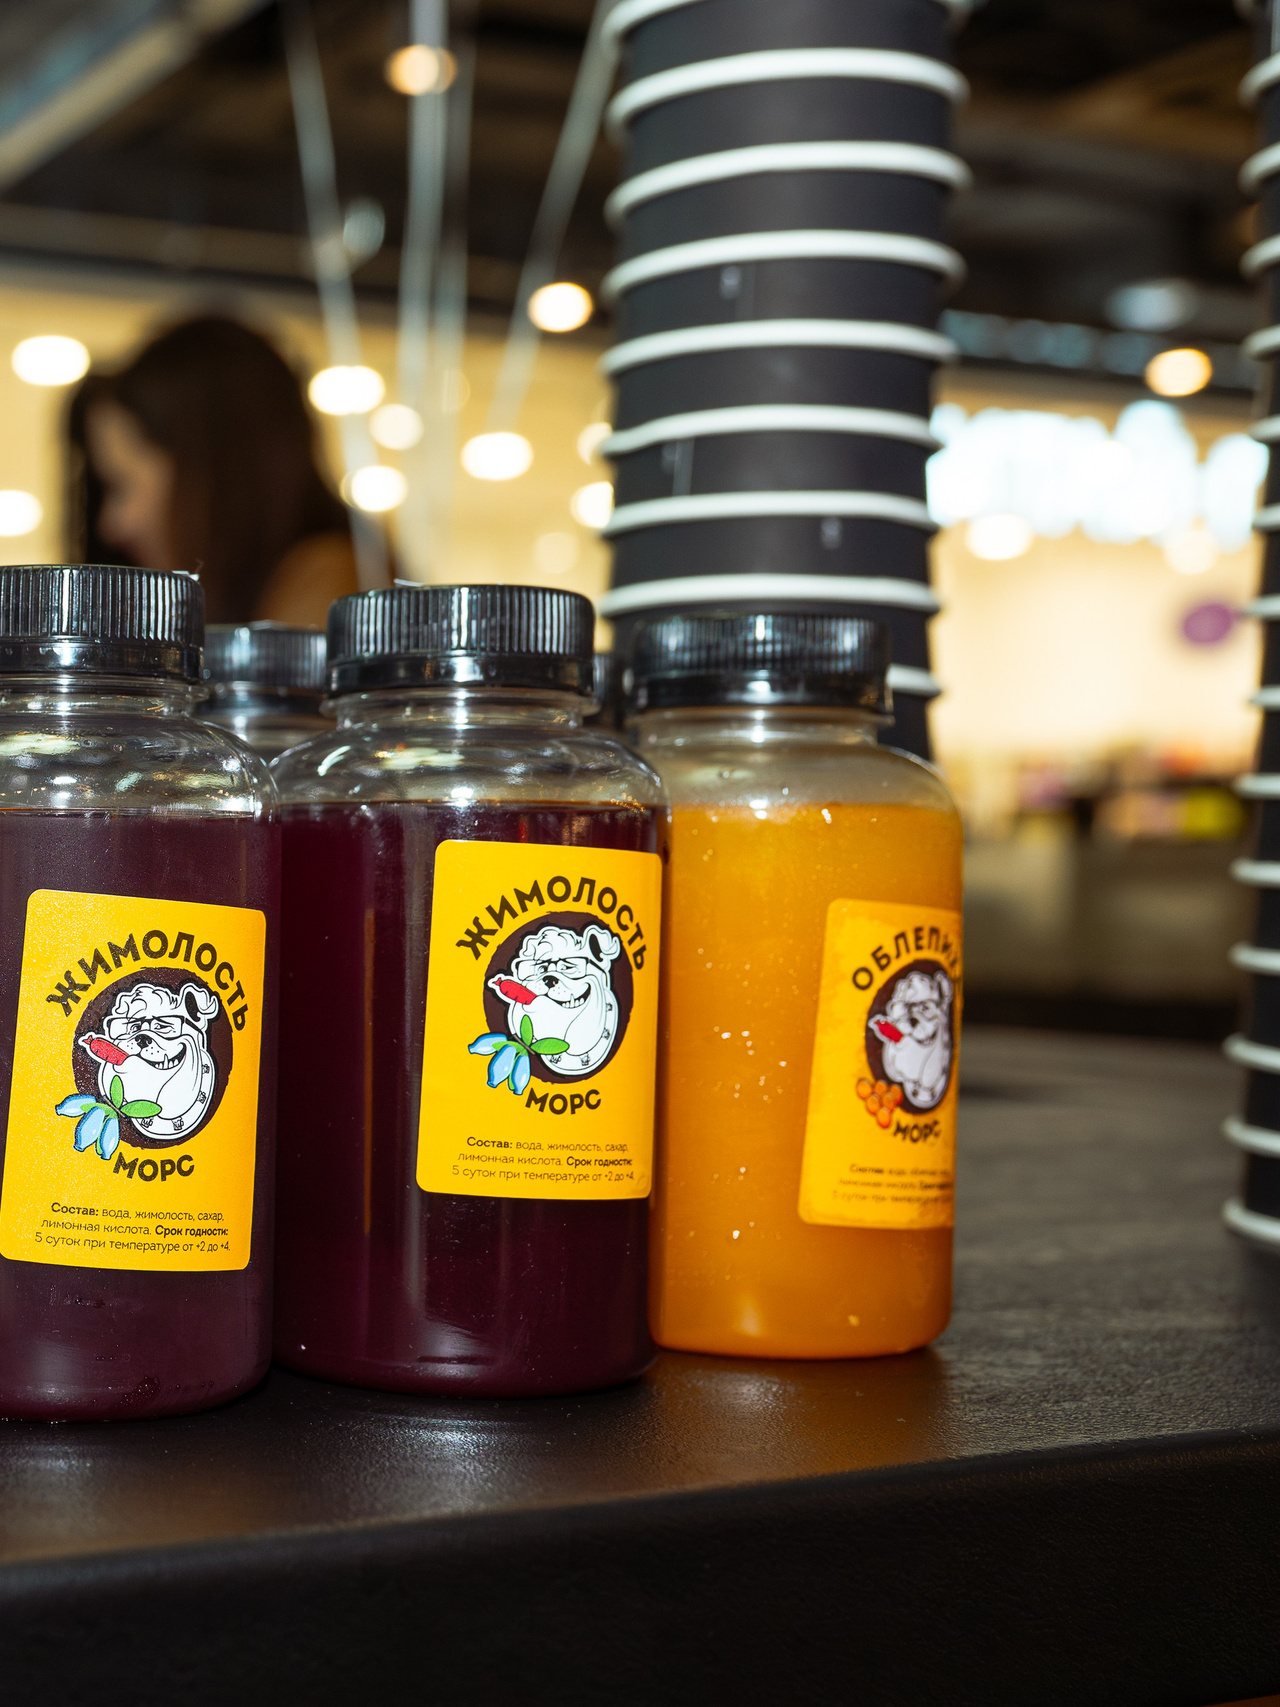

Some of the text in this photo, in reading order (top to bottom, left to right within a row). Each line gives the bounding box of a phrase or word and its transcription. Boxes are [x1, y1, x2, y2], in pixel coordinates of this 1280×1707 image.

[456, 875, 647, 970] ЖИМОЛОСТЬ
[45, 929, 249, 1031] ЖИМОЛОСТЬ
[525, 1087, 601, 1115] МОРС
[467, 1136, 513, 1149] Состав:
[516, 1142, 544, 1151] вода,
[547, 1143, 603, 1152] жимолость,
[113, 1152, 195, 1181] МОРС
[458, 1152, 514, 1164] лимонная
[518, 1157, 563, 1166] кислота.
[566, 1156, 592, 1169] Срок
[452, 1165, 459, 1176] 5
[463, 1168, 496, 1180] суток
[499, 1171, 520, 1181] при
[524, 1172, 590, 1184] температуре
[592, 1173, 603, 1182] от
[51, 1202, 99, 1217] Состав:
[102, 1209, 132, 1220] вода,
[135, 1210, 196, 1221] жимолость,
[41, 1219, 229, 1238] лимонная кислота. Срок годности:
[35, 1232, 42, 1242] 5
[45, 1235, 80, 1247] суток
[83, 1238, 106, 1250] при
[109, 1240, 180, 1254] температуре
[182, 1243, 194, 1251] от
[196, 1240, 206, 1252] +2
[207, 1243, 219, 1253] до
